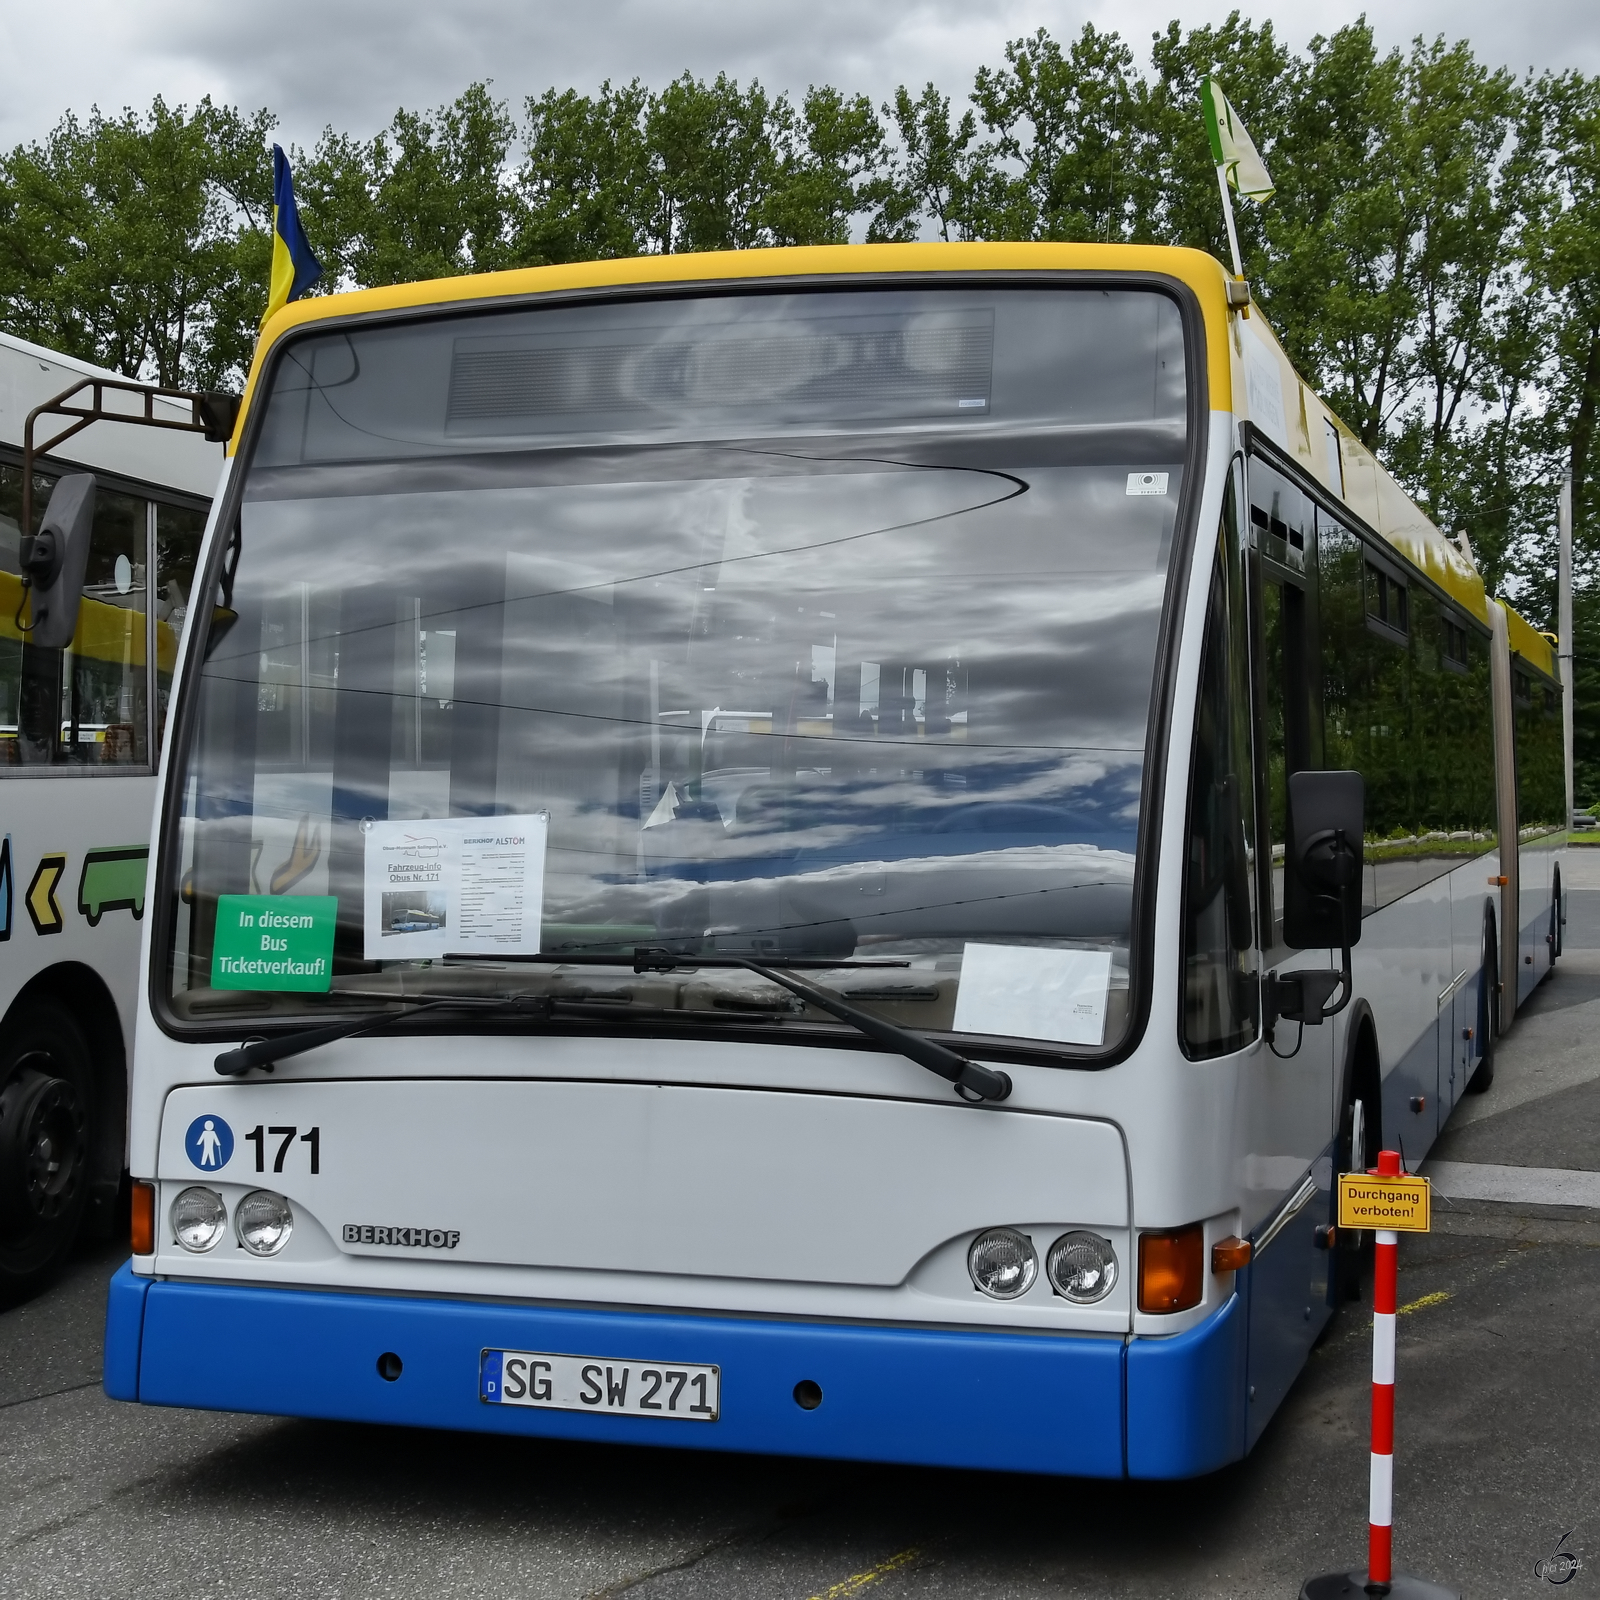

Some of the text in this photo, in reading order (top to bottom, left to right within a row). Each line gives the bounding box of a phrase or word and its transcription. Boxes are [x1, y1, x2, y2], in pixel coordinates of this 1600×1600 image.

[495, 836, 525, 845] ALSTOM
[387, 862, 442, 872] Fahrzeug-Info
[389, 873, 440, 882] Obus Nr. 171
[239, 910, 314, 929] In diesem
[260, 934, 288, 951] Bus
[219, 956, 326, 976] Ticketverkauf!
[245, 1124, 320, 1175] 171
[1348, 1187, 1420, 1204] Durchgang
[1352, 1205, 1414, 1218] verboten!
[343, 1224, 461, 1249] BERKHOF
[487, 1381, 496, 1393] D
[503, 1358, 713, 1413] SG SW 271
